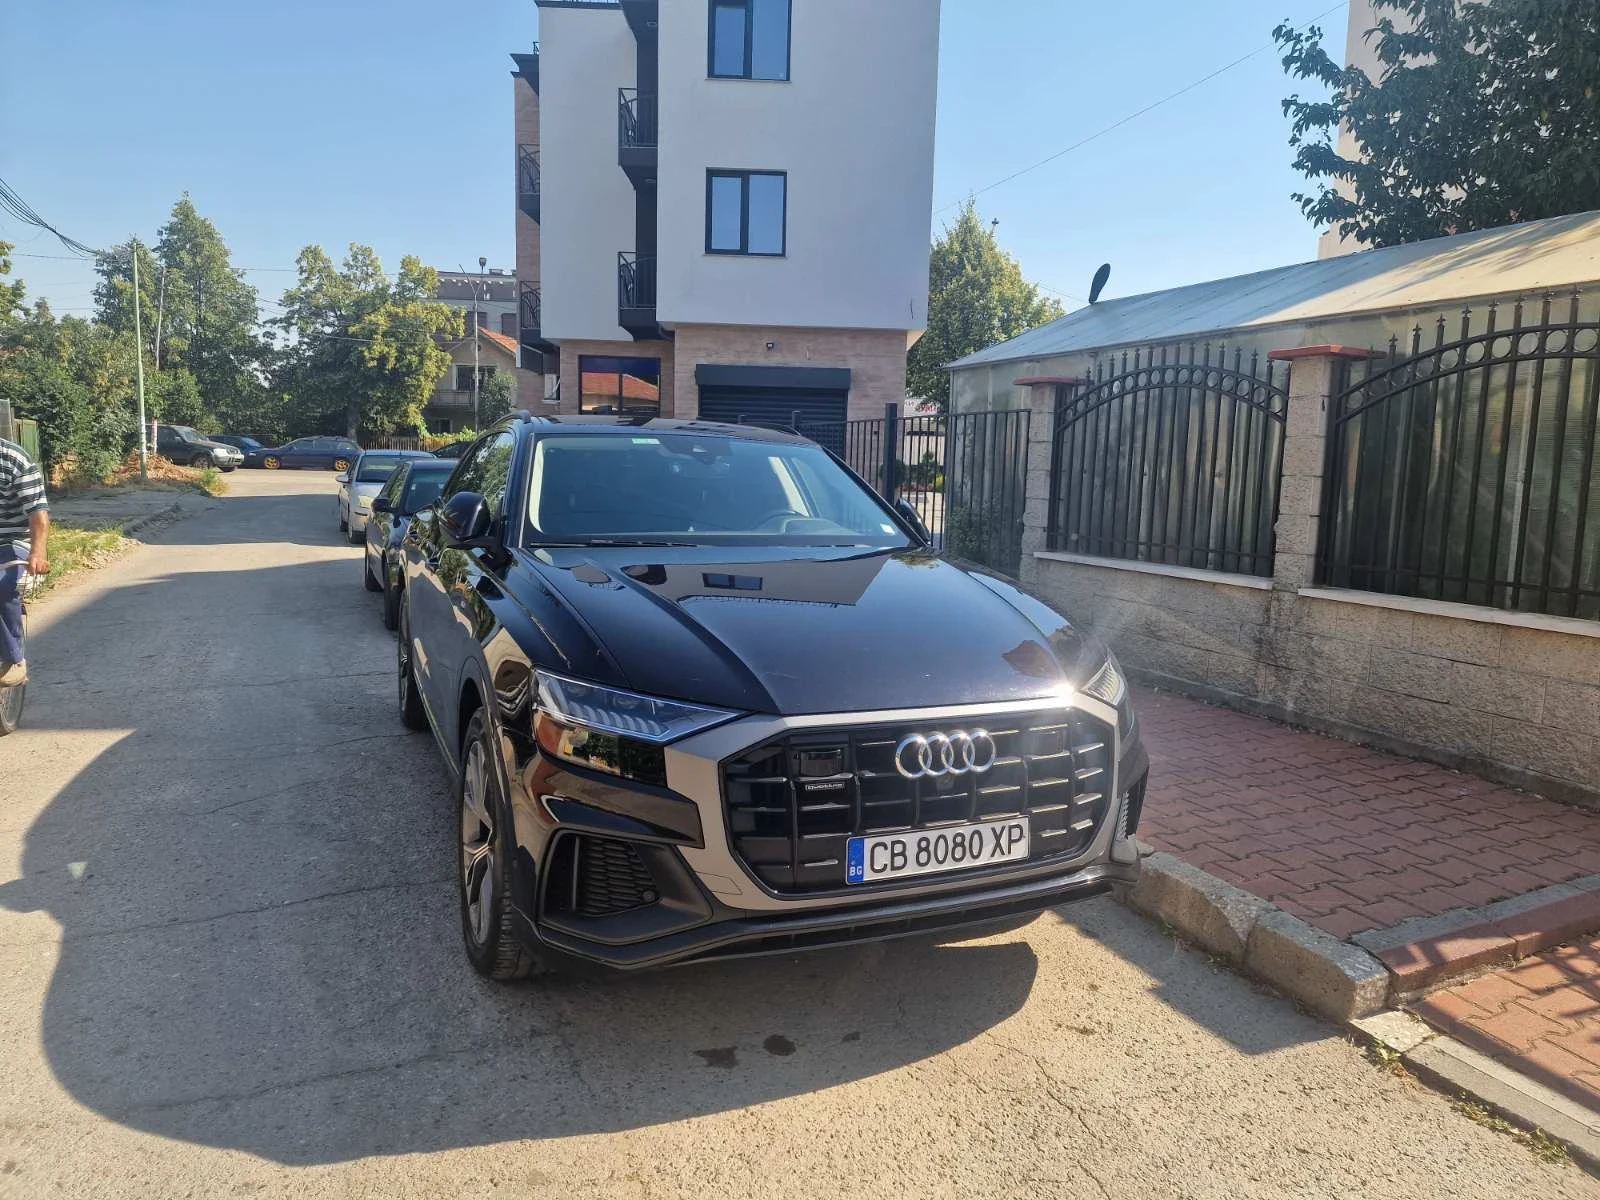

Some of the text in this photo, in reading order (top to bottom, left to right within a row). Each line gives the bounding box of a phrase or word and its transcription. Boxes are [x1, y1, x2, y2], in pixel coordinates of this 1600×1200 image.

[870, 823, 1024, 874] CB 8080 XP
[849, 866, 863, 877] BG
